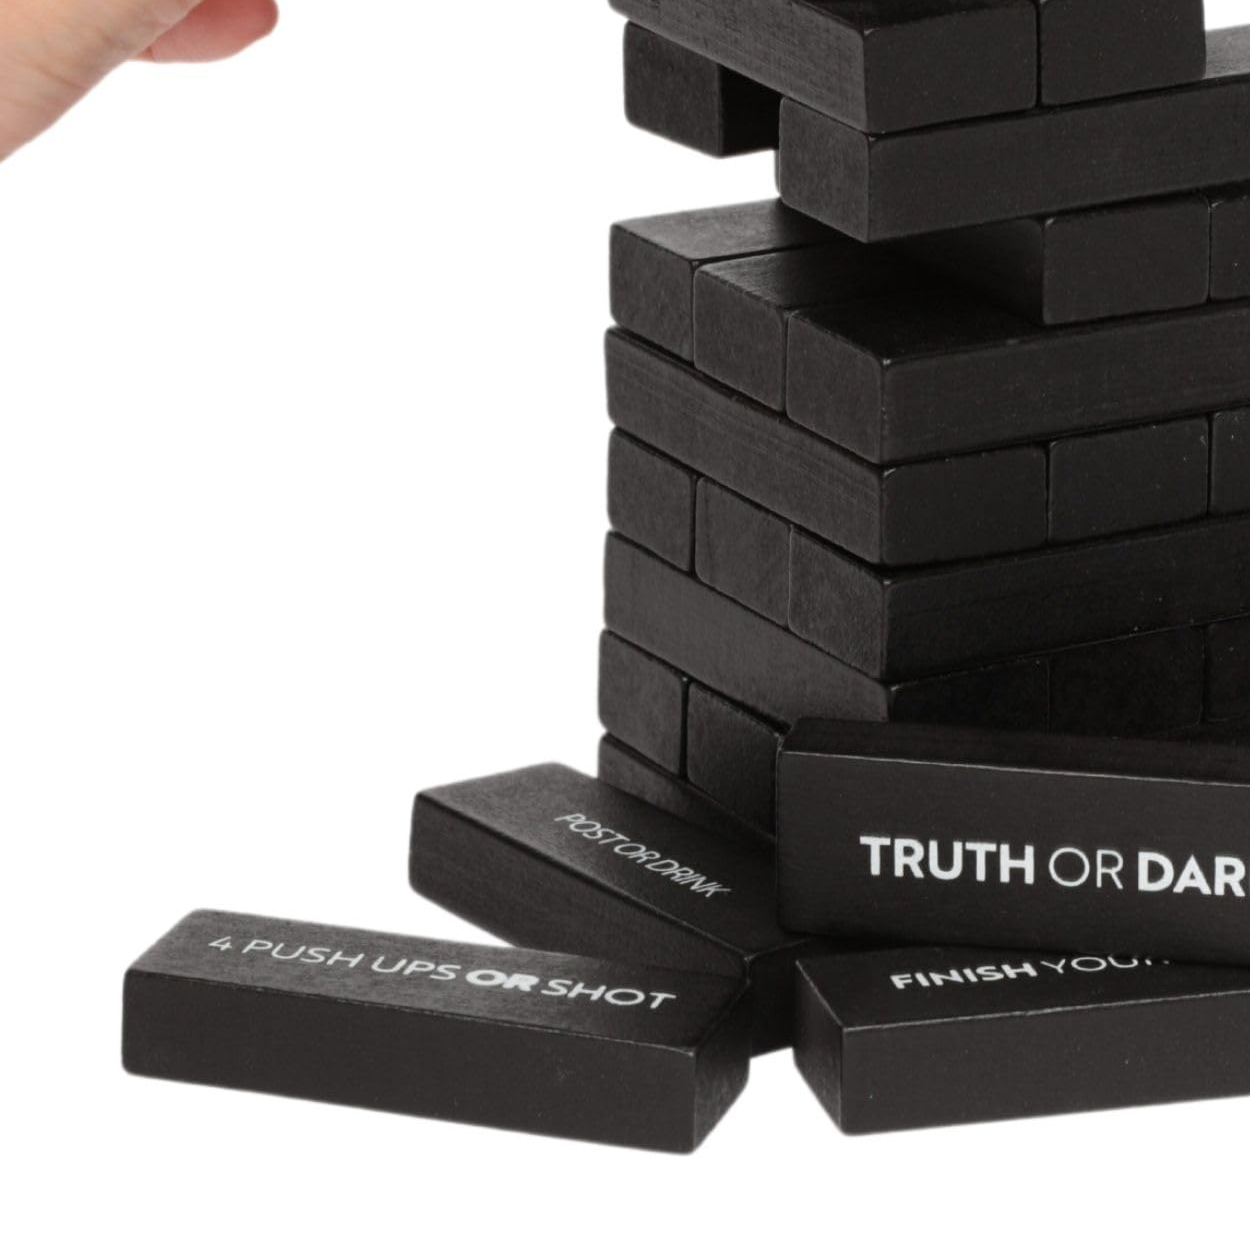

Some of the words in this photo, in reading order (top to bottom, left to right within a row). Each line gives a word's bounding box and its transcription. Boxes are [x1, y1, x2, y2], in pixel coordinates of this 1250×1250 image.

[554, 813, 631, 844] POST
[613, 843, 661, 863] OR
[645, 859, 731, 897] DRINK
[859, 835, 1035, 885] TRUTH
[1048, 847, 1124, 890] OR
[207, 935, 233, 951] 4
[241, 938, 365, 969] PUSH
[370, 955, 462, 981] UPS
[464, 968, 541, 993] OR
[540, 978, 676, 1009] SHOT
[890, 962, 1038, 989] FINISH
[1040, 956, 1170, 974] YOU
